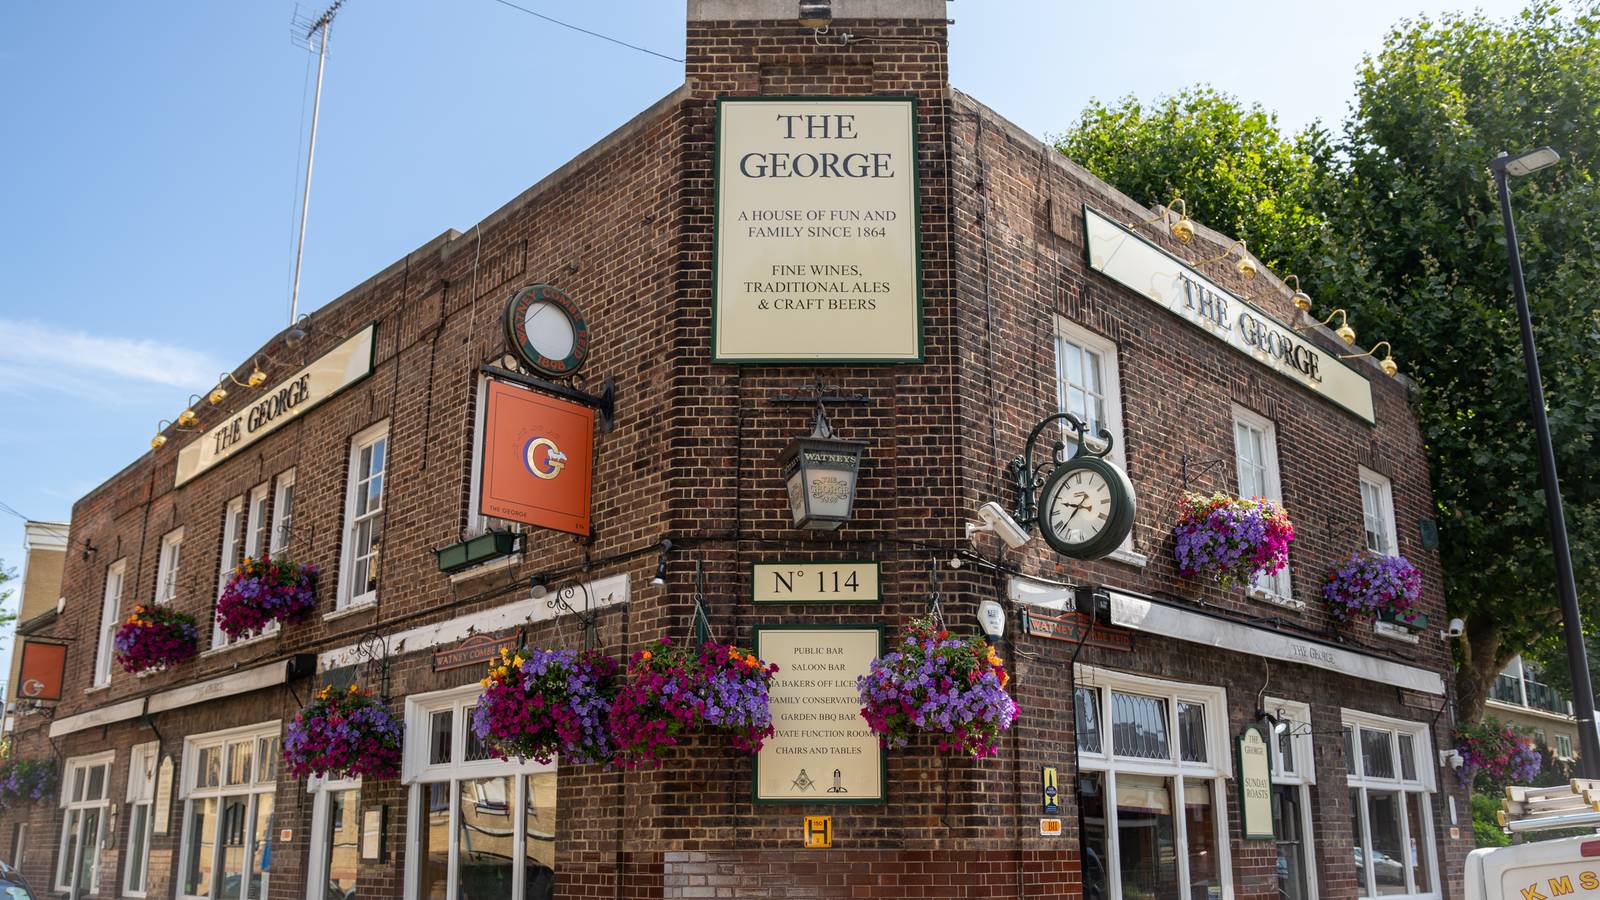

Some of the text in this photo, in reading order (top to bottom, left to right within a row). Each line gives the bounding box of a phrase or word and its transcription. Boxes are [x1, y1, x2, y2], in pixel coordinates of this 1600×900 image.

[776, 113, 858, 140] THE
[739, 152, 895, 179] GEORGE
[738, 209, 897, 222] A HOUSE OF FUN AND
[748, 226, 886, 238] FAMILY SINCE 1864
[772, 264, 863, 277] FINE WINES,
[743, 281, 891, 293] TRADITIONAL ALES
[757, 298, 877, 311] & CRAFT BEERS
[1179, 271, 1322, 384] THE GEORGE
[214, 373, 310, 455] THE GEORGE
[804, 453, 857, 463] WATNEYS
[817, 570, 860, 593] 114
[1029, 619, 1073, 636] WATNEY
[436, 654, 469, 666] WATNEY
[470, 646, 496, 659] COMBE
[793, 647, 844, 655] PUBLIC BAR
[791, 663, 846, 672] SALOON BAR
[781, 679, 816, 688] BAKERS
[816, 679, 834, 688] OFF
[835, 679, 859, 688] LICEN
[768, 696, 800, 705] FAMILY
[780, 713, 857, 722] GARDEN BBQ BAR
[801, 729, 845, 738] FUNCTION
[1247, 735, 1259, 744] THE
[775, 746, 863, 755] CHAIRS AND TABLES
[1245, 777, 1268, 788] SUNDAY
[1246, 788, 1268, 799] ROASTS
[808, 819, 828, 845] H
